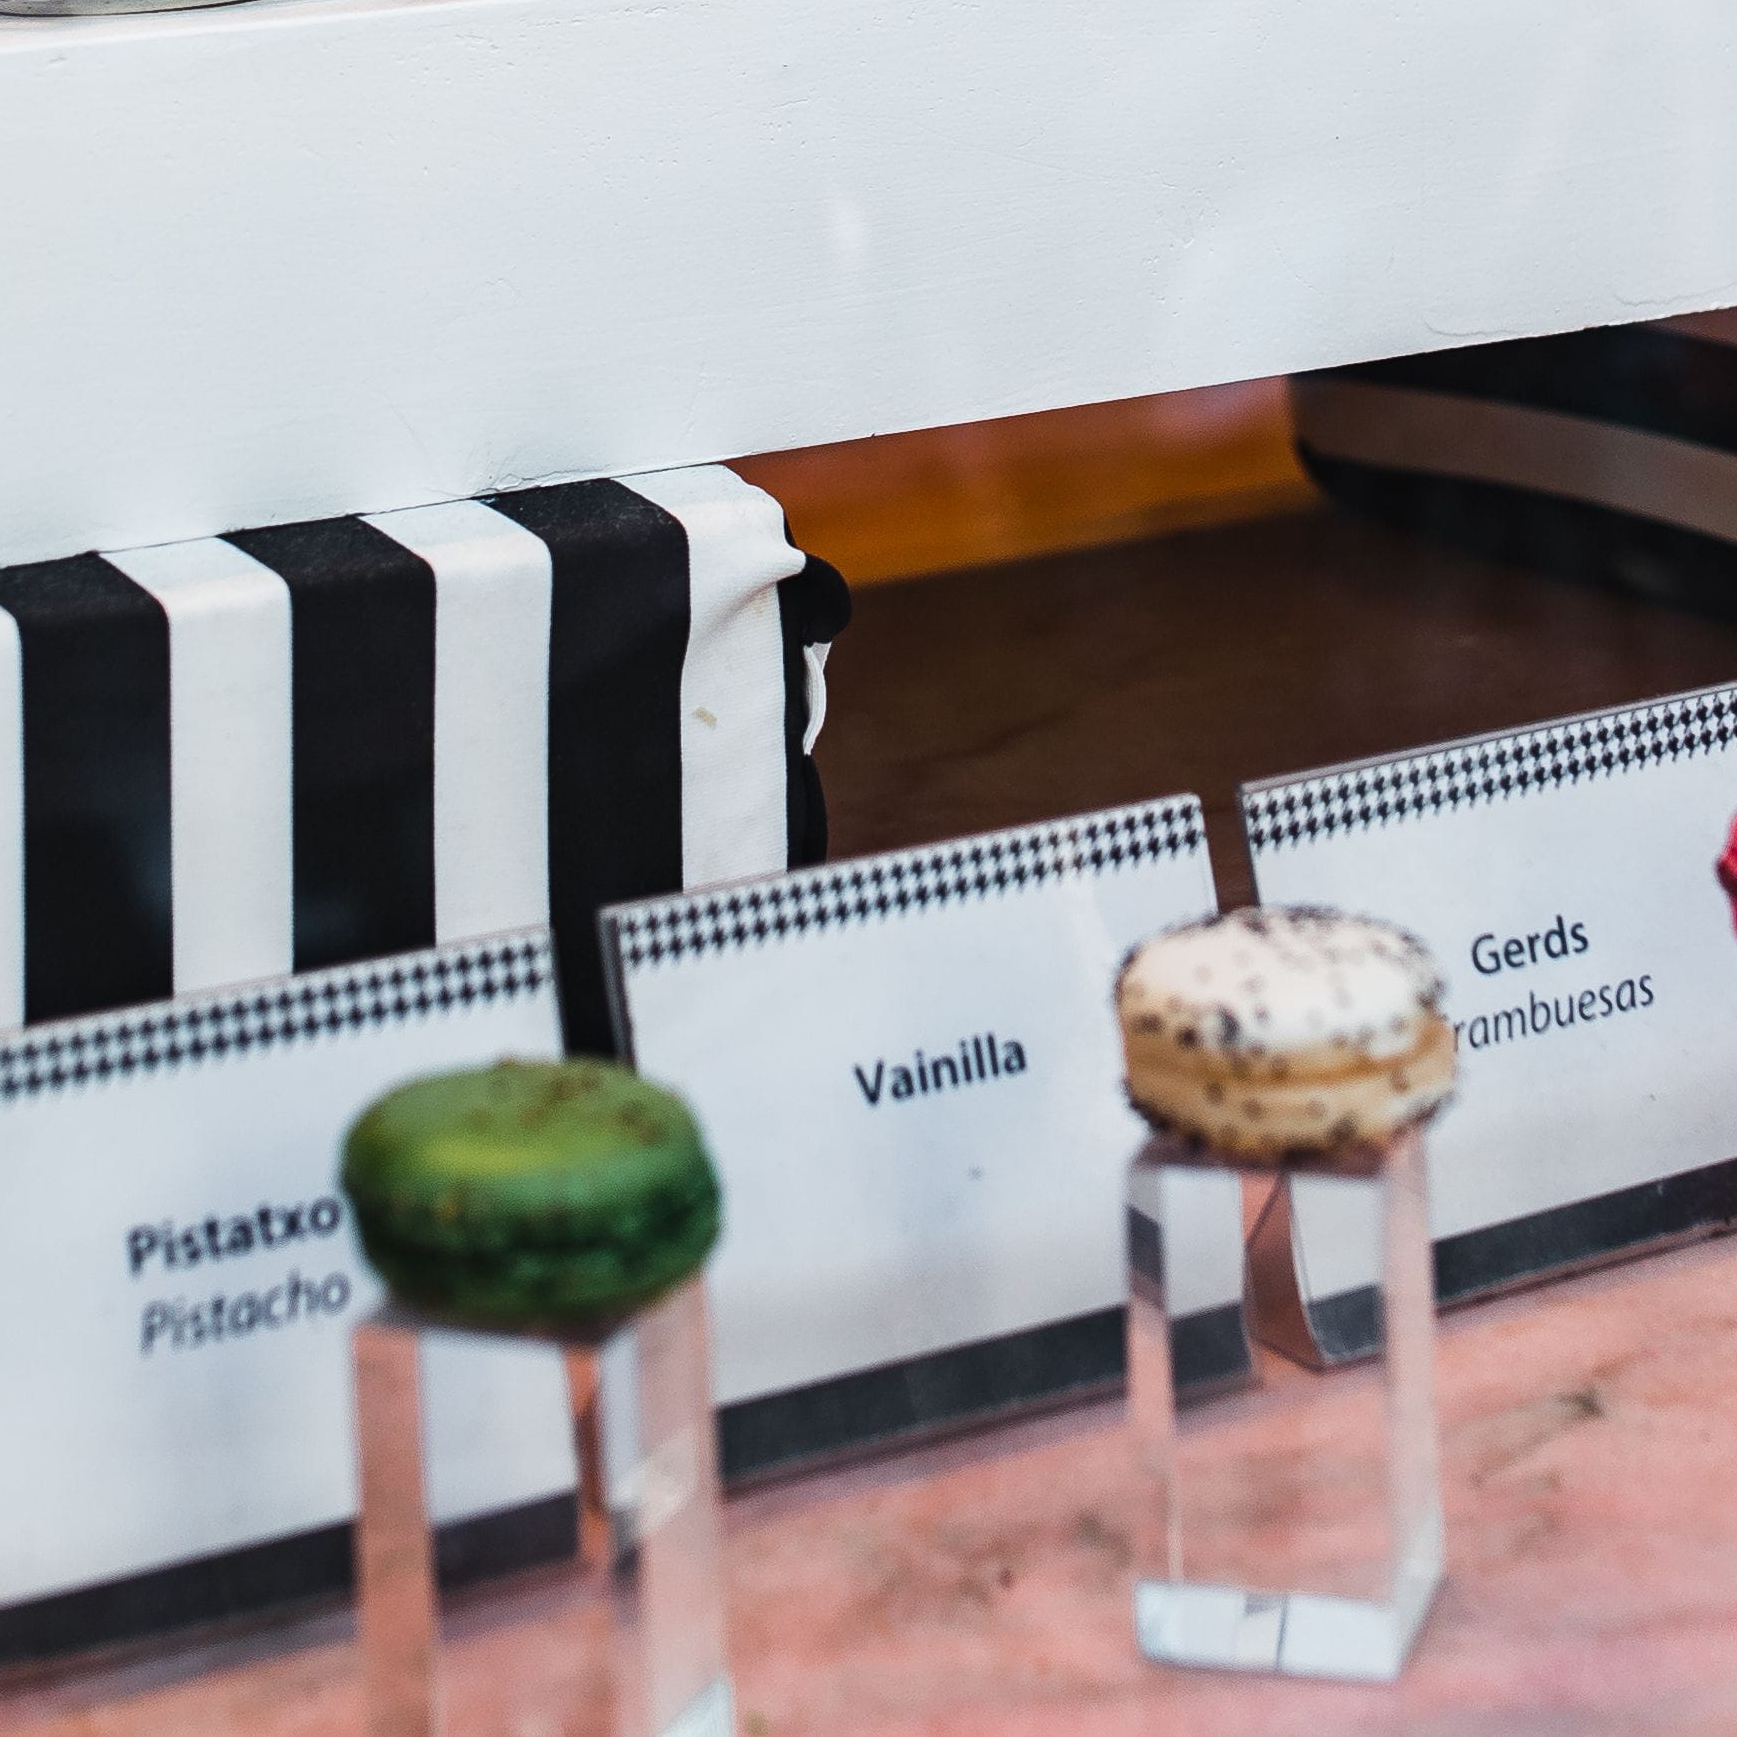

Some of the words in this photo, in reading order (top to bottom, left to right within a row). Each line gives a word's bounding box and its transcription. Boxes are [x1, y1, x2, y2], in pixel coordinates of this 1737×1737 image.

[1469, 912, 1591, 978] Gerds
[1446, 971, 1657, 1055] rambuesas
[852, 1029, 1030, 1108] Vainilla
[124, 1192, 343, 1277] Pistatxo
[137, 1270, 353, 1356] Pistacho
